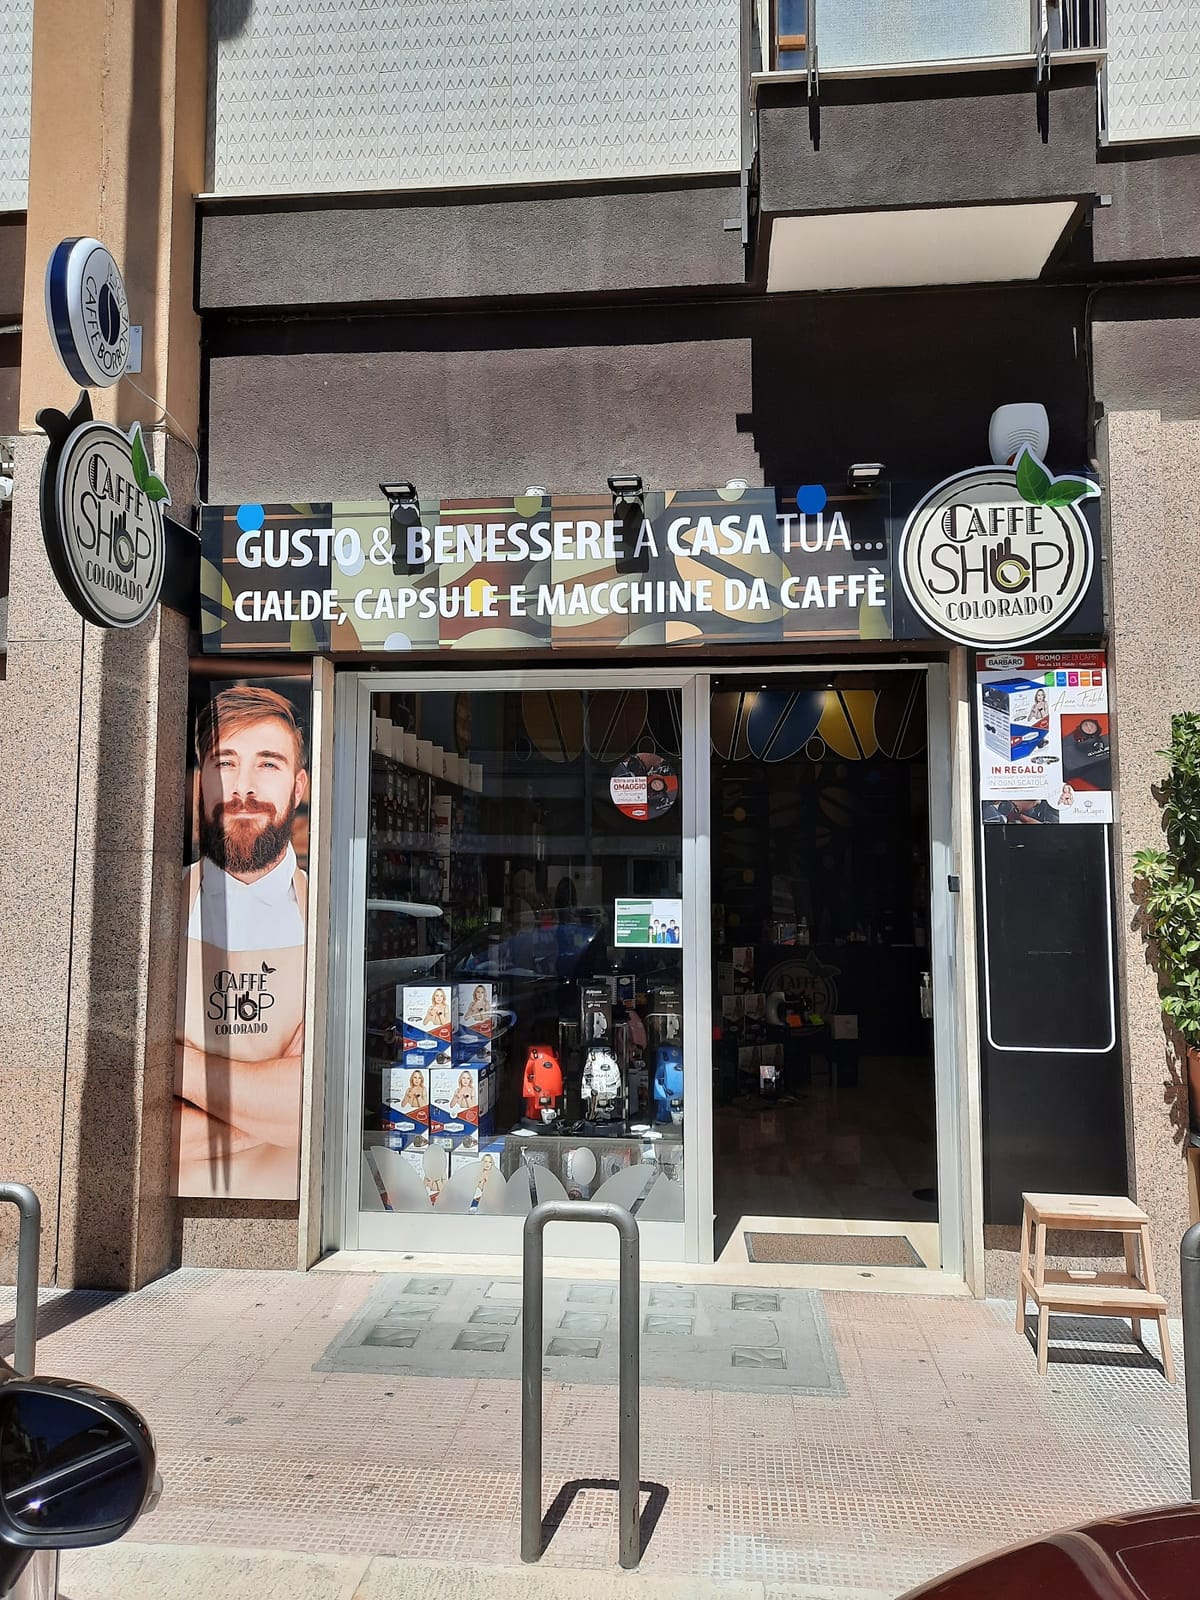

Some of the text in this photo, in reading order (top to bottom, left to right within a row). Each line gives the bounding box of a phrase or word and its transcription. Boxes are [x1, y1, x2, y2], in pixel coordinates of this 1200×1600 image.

[88, 453, 144, 522] CAFFE
[77, 491, 151, 579] SHOP
[236, 512, 884, 568] GUSTO & BENESSERE A CASA TUA...
[941, 503, 1043, 543] CAFFE
[85, 560, 144, 604] COLORADO
[928, 538, 1064, 595] SHOP
[234, 567, 887, 626] CIALDE, CAPSULE E MACCHINE DA CAFFÈ
[945, 595, 1053, 622] COLORADO
[991, 765, 1044, 774] IN REGALO
[214, 970, 268, 993] CAFFE
[207, 991, 275, 1021] SHOP
[215, 1023, 268, 1036] COLORADO
